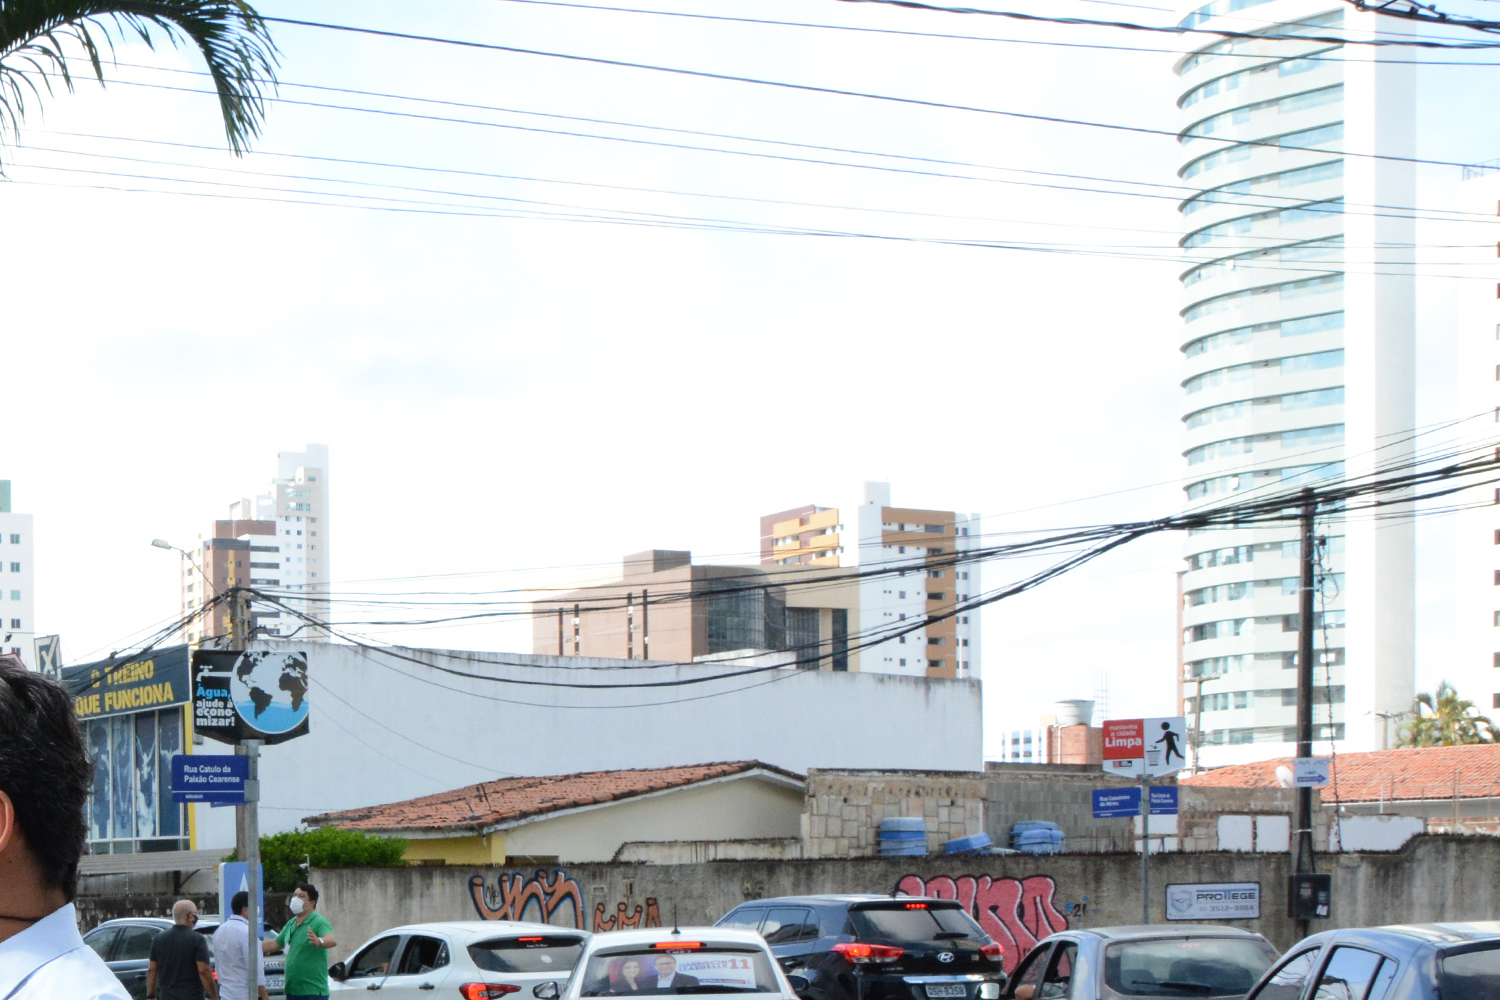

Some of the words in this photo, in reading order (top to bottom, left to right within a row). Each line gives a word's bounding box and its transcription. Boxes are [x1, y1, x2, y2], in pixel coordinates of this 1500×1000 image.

[75, 694, 101, 717] QUE
[104, 681, 174, 712] FUNCIONA
[196, 699, 224, 710] ajude
[196, 715, 235, 727] mizar!
[1105, 737, 1142, 749] Limpa
[183, 765, 198, 773] Rua
[199, 765, 221, 773] Catulo
[222, 765, 231, 773] da
[208, 775, 240, 783] Cearense
